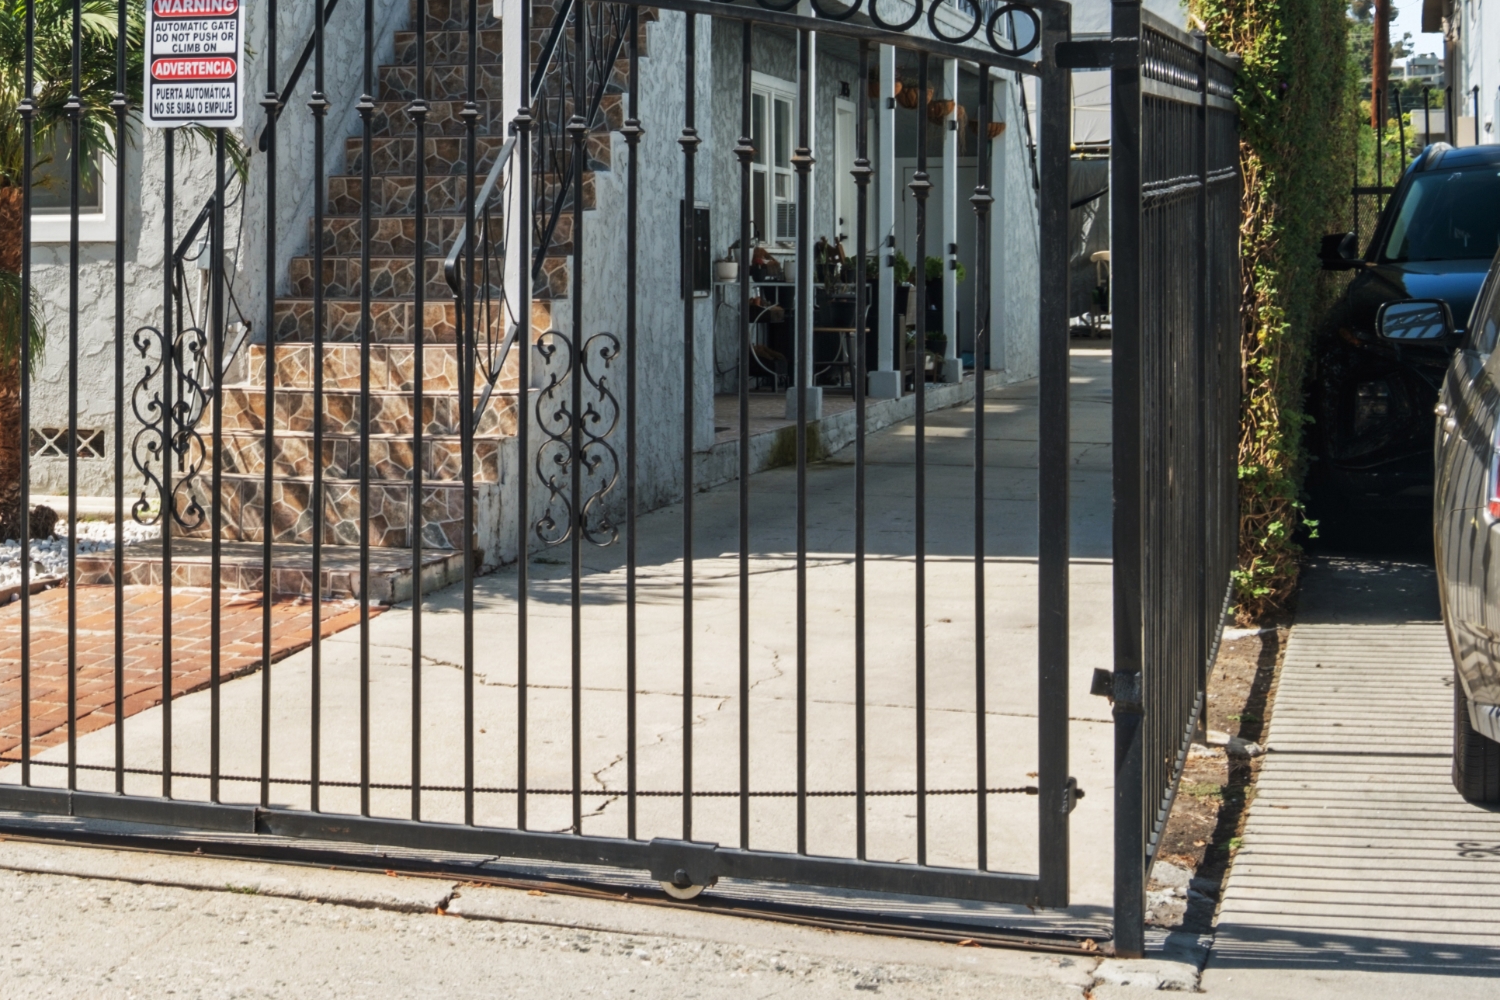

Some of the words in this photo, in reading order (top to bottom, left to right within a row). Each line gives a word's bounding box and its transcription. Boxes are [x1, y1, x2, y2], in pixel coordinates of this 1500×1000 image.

[155, 22, 208, 32] AUTOMATIC
[211, 21, 235, 31] GATE
[156, 33, 169, 43] DO
[171, 33, 190, 42] NOT
[193, 32, 218, 42] PUSH
[221, 32, 234, 41] OR
[172, 44, 201, 53] CLIMB
[203, 43, 217, 52] ON
[155, 61, 233, 75] ADVERTENCIA
[156, 88, 183, 100] PUERTA
[154, 103, 164, 114] NO
[166, 102, 175, 114] SE
[177, 102, 195, 114] SUBA
[197, 102, 203, 113] O
[205, 102, 233, 114] EMPUJE
